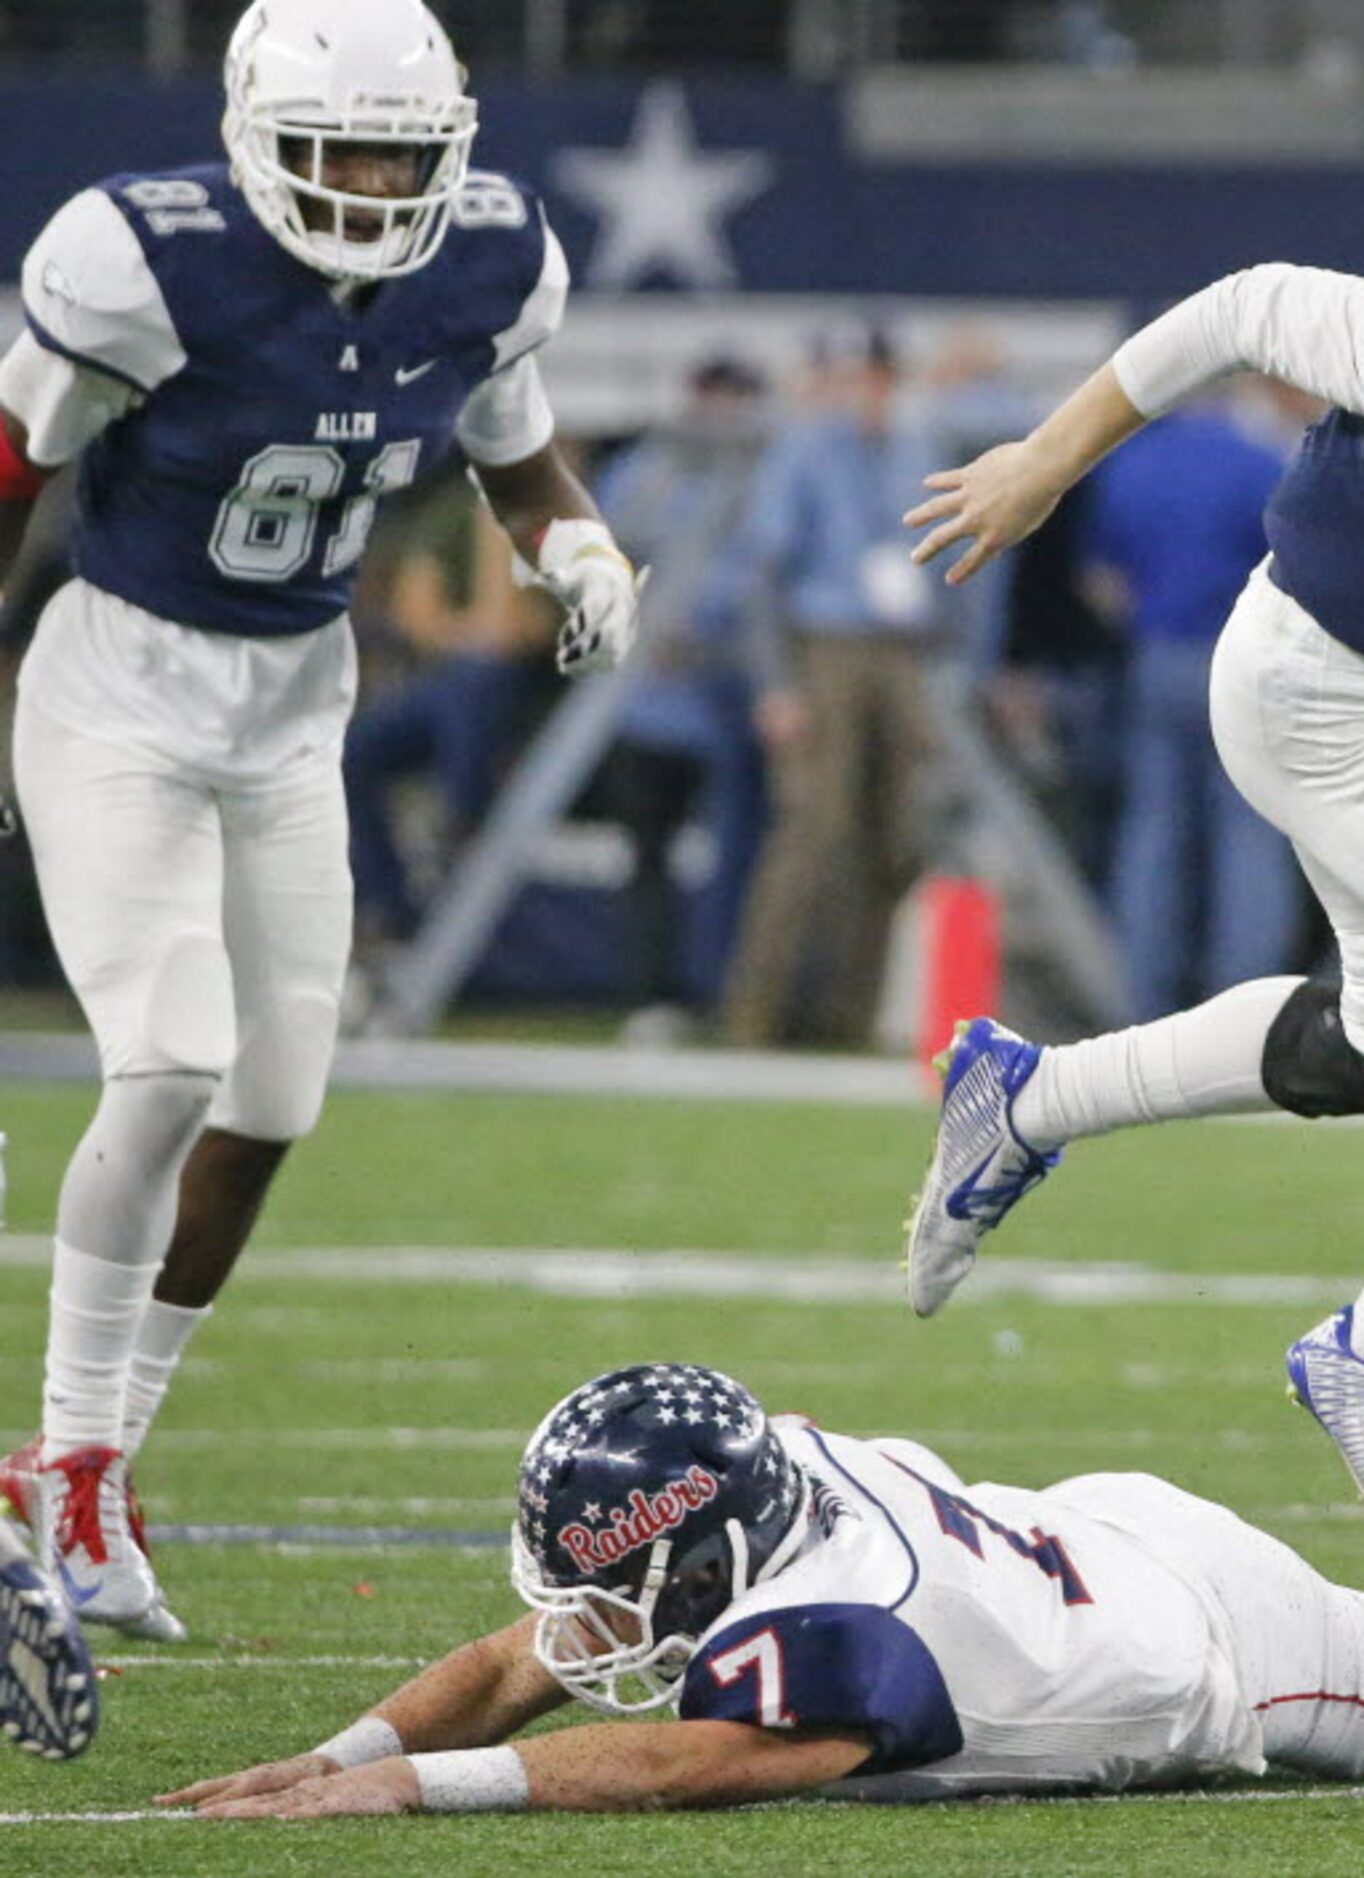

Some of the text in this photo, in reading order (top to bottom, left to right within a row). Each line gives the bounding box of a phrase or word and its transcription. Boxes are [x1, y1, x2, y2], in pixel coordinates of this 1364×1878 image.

[123, 180, 228, 237] 81
[338, 344, 359, 371] A
[314, 411, 377, 441] ALLEN
[208, 438, 423, 582] 81
[556, 1464, 718, 1576] Raiders
[709, 1626, 798, 1728] 7
